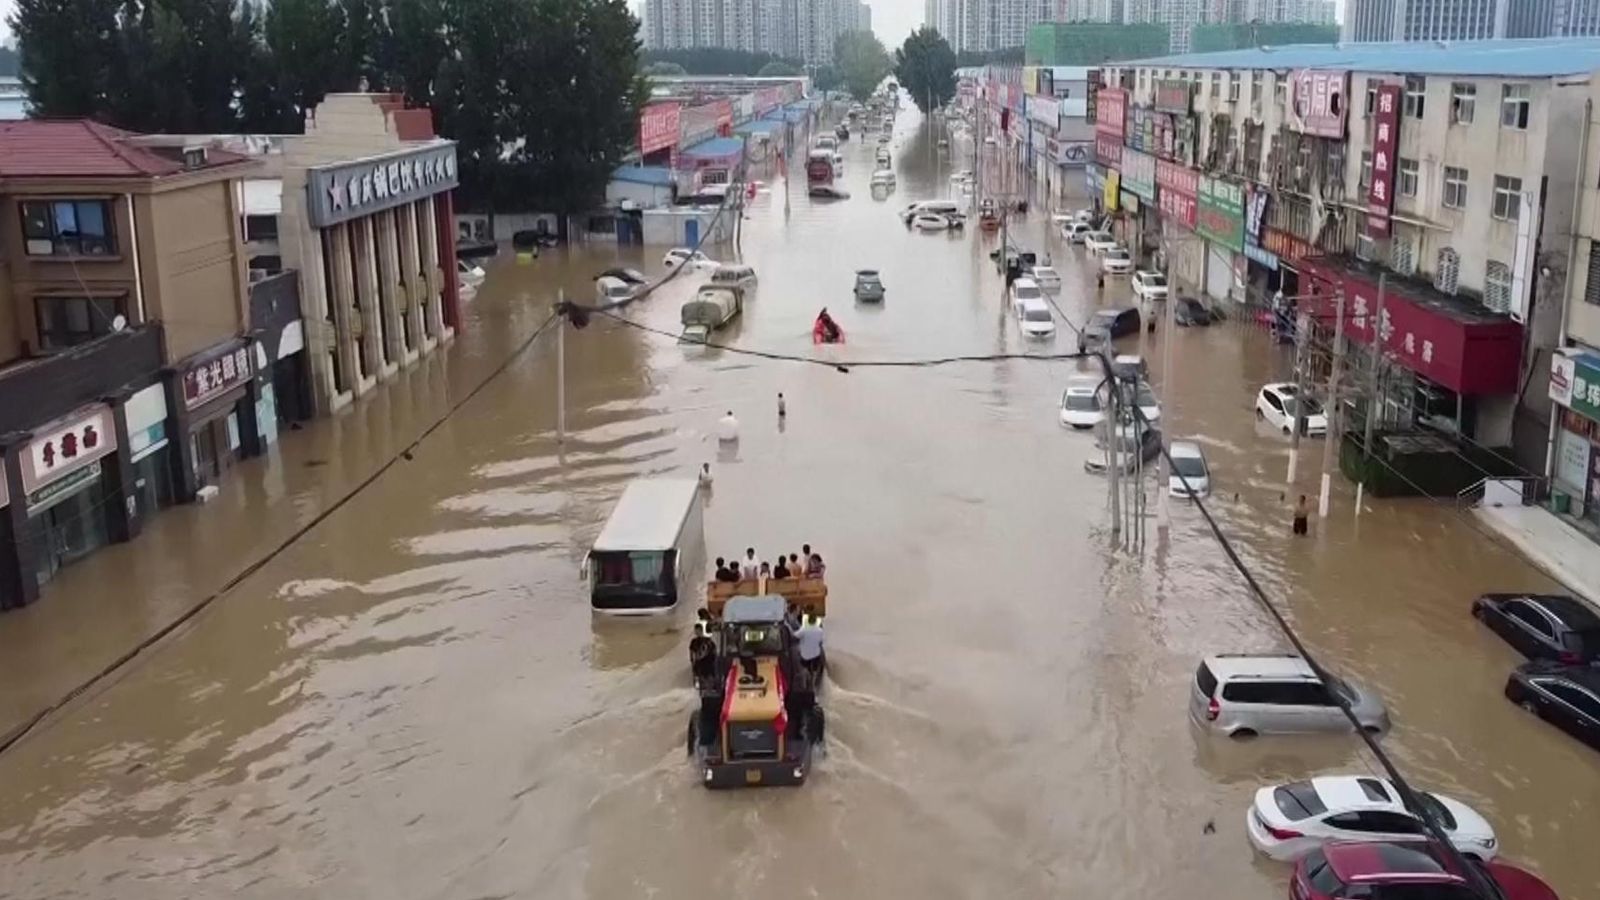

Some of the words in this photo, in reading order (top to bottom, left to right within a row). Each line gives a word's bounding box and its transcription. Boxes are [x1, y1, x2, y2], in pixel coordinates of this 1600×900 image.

[1374, 94, 1393, 201] 招商热线
[196, 348, 249, 395] 紫光眼镜
